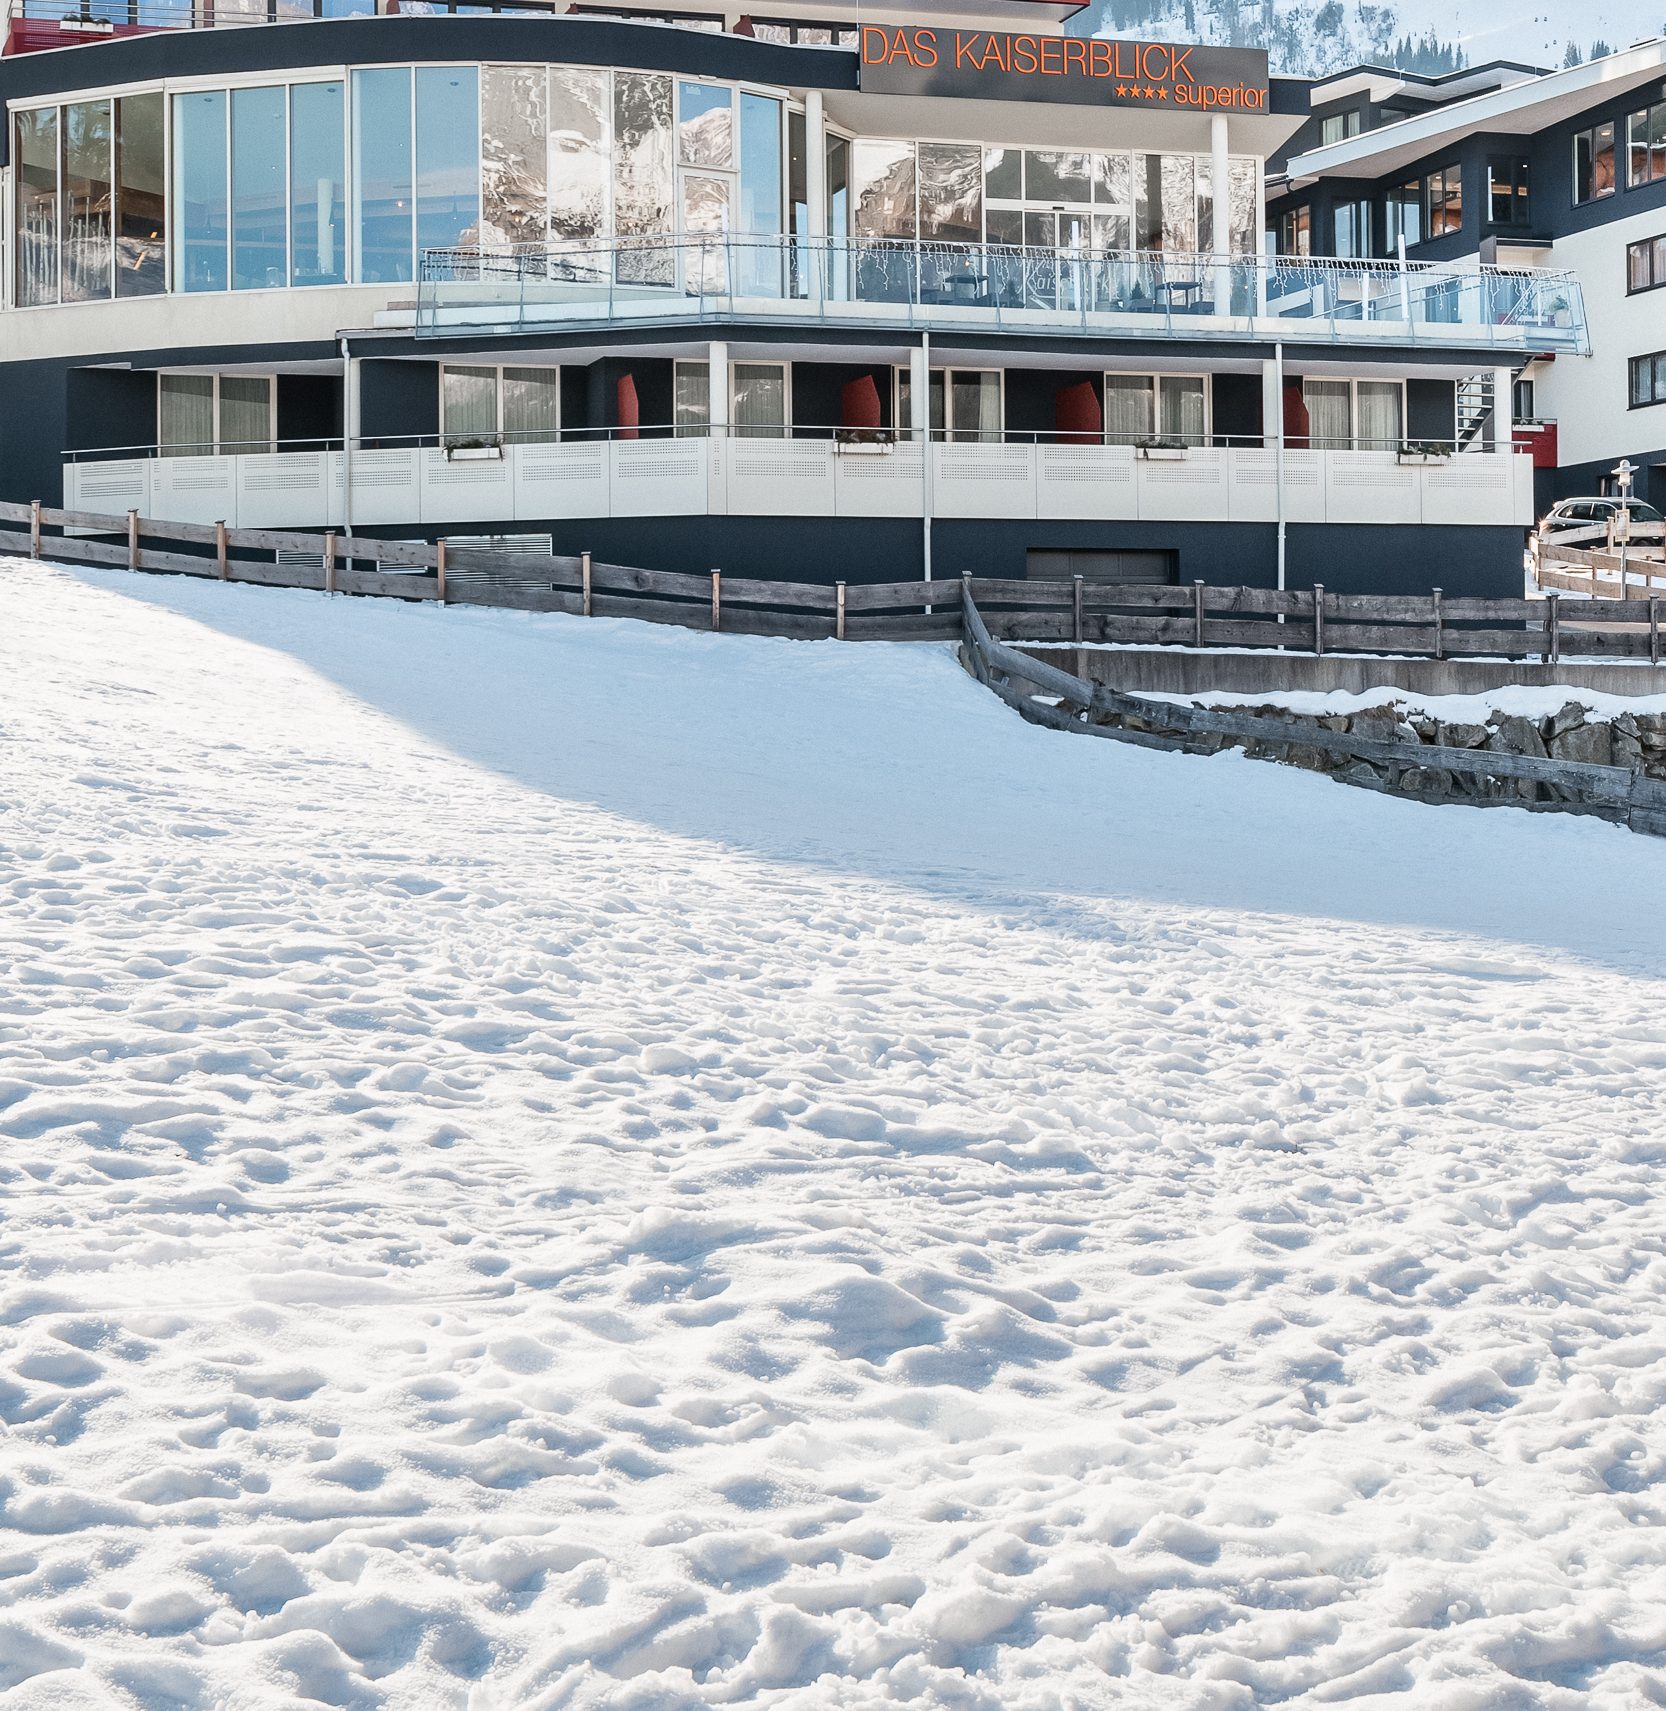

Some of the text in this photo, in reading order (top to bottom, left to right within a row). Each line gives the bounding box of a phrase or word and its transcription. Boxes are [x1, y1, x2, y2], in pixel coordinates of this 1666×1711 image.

[862, 26, 1195, 83] DAS KAISERBLICK
[1174, 81, 1269, 111] superior
